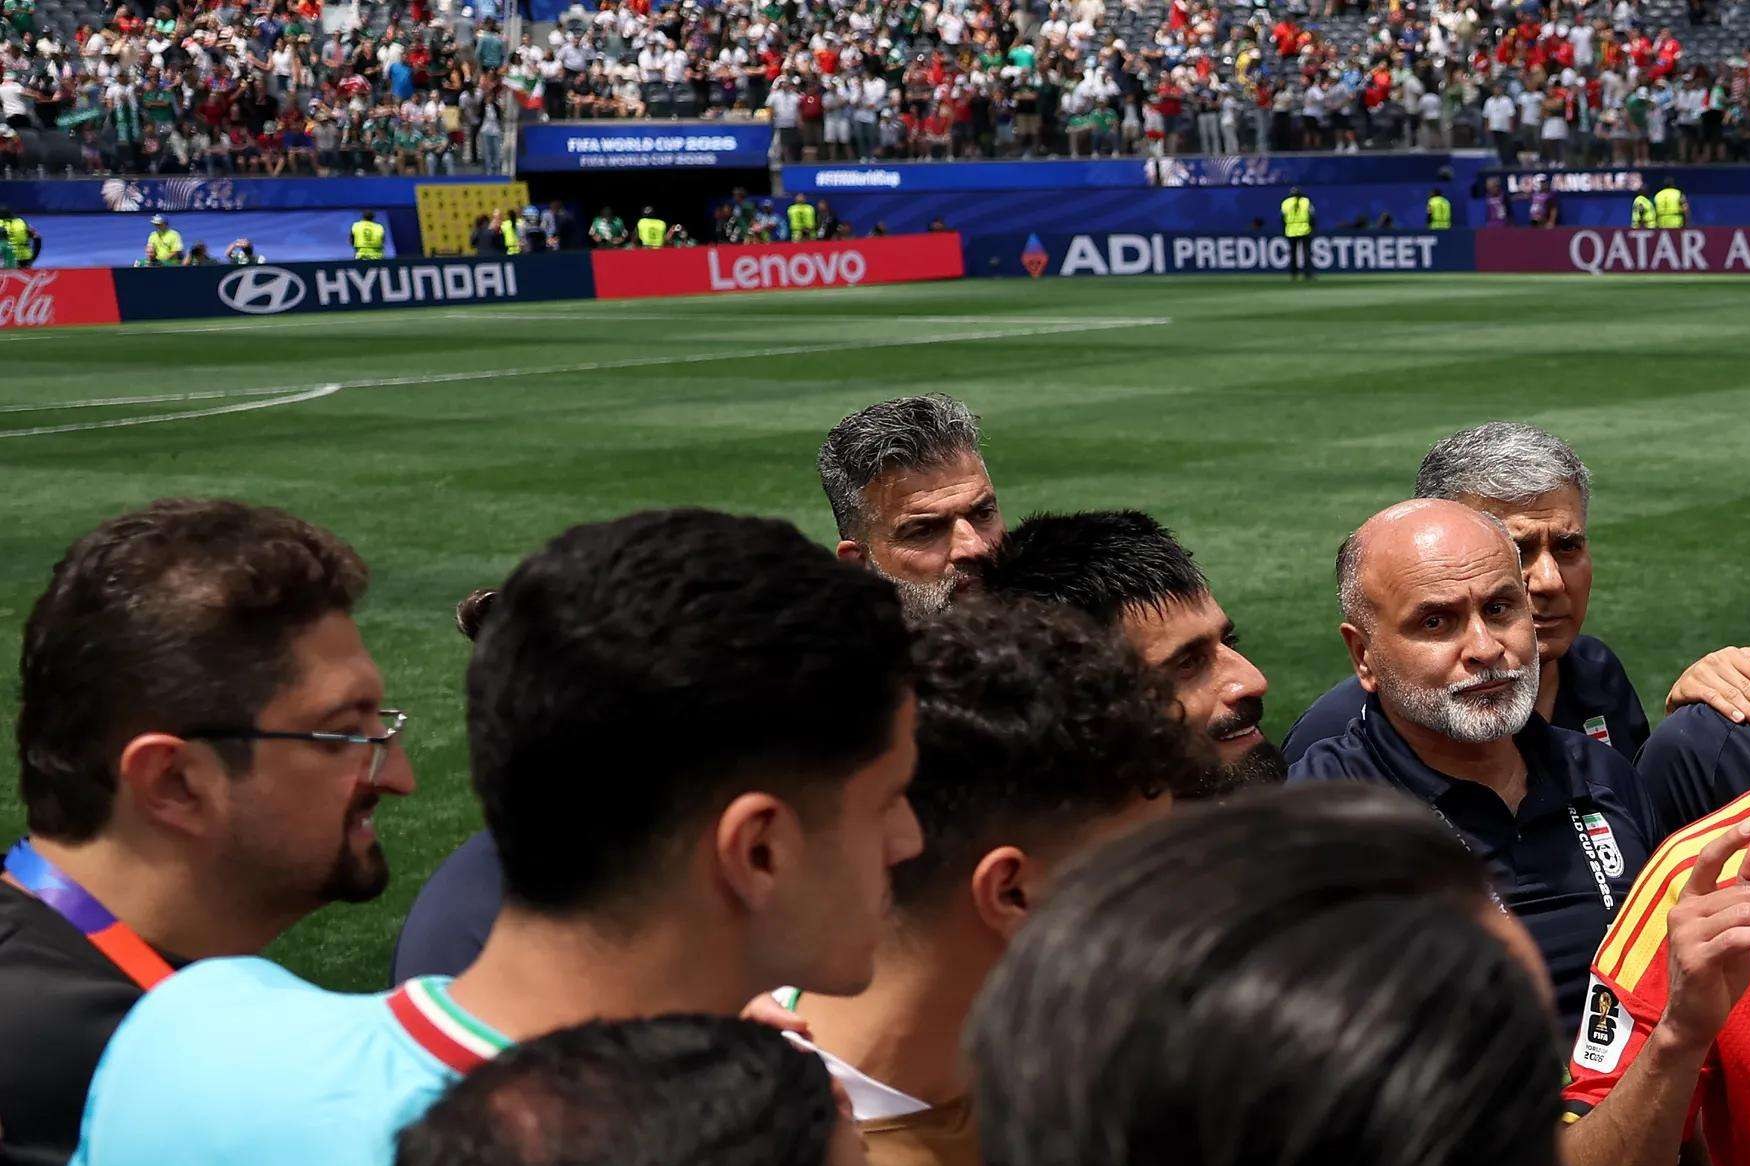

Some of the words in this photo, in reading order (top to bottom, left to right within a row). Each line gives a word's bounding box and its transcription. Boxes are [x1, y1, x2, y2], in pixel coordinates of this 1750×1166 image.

[600, 136, 654, 152] WORLD
[708, 248, 866, 291] Lenovo
[1060, 233, 1166, 276] ADI
[1310, 236, 1438, 269] STREET
[1569, 230, 1709, 276] QATAR
[315, 262, 518, 306] HYUNDAI
[1578, 832, 1597, 860] CUP
[1593, 1031, 1609, 1042] FIFA
